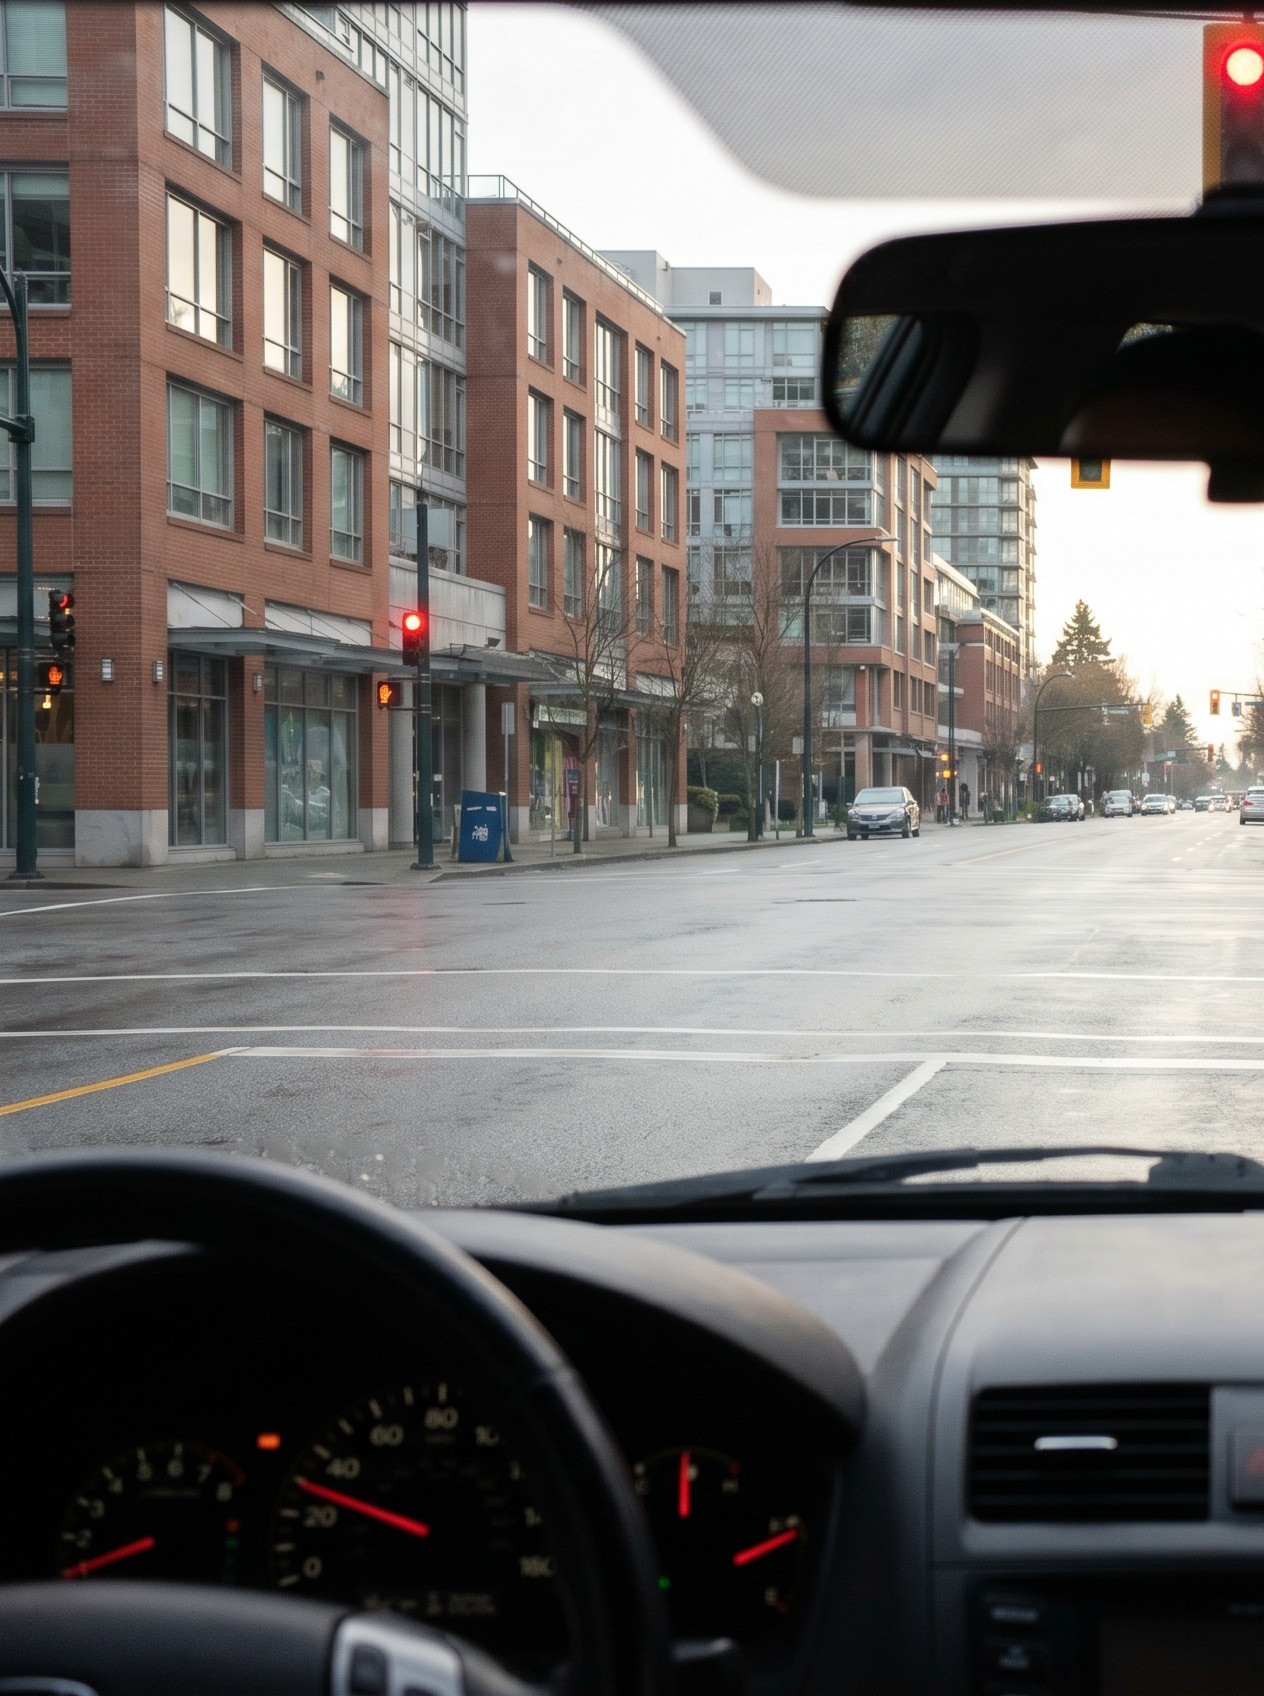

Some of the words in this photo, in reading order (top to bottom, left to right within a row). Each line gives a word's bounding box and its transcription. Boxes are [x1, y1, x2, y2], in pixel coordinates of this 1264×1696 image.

[424, 1406, 458, 1429] 80
[370, 1424, 404, 1447] 60
[326, 1457, 360, 1480] 40
[303, 1505, 338, 1529] 20
[303, 1556, 322, 1579] 0
